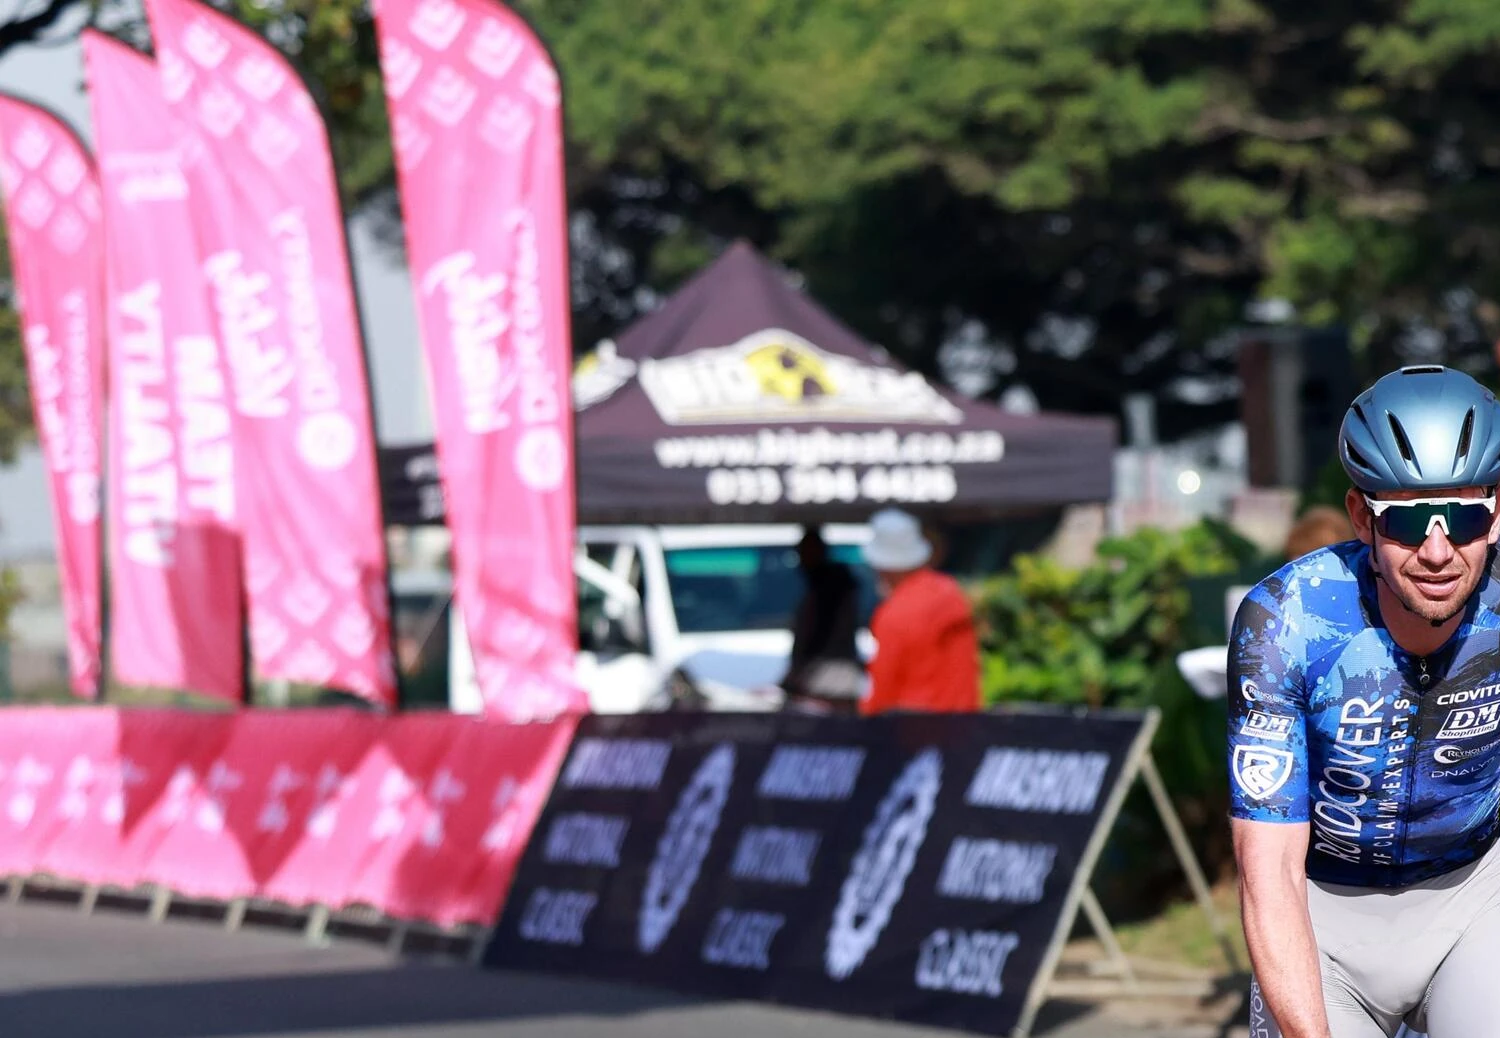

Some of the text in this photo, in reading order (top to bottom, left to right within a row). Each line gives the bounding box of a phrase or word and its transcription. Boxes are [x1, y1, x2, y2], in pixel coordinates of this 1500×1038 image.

[1248, 713, 1290, 733] DM
[1448, 702, 1500, 729] DM
[1382, 699, 1410, 790] EXPERTS
[1314, 697, 1384, 863] ROADCOVER
[1374, 799, 1399, 847] CLAIM
